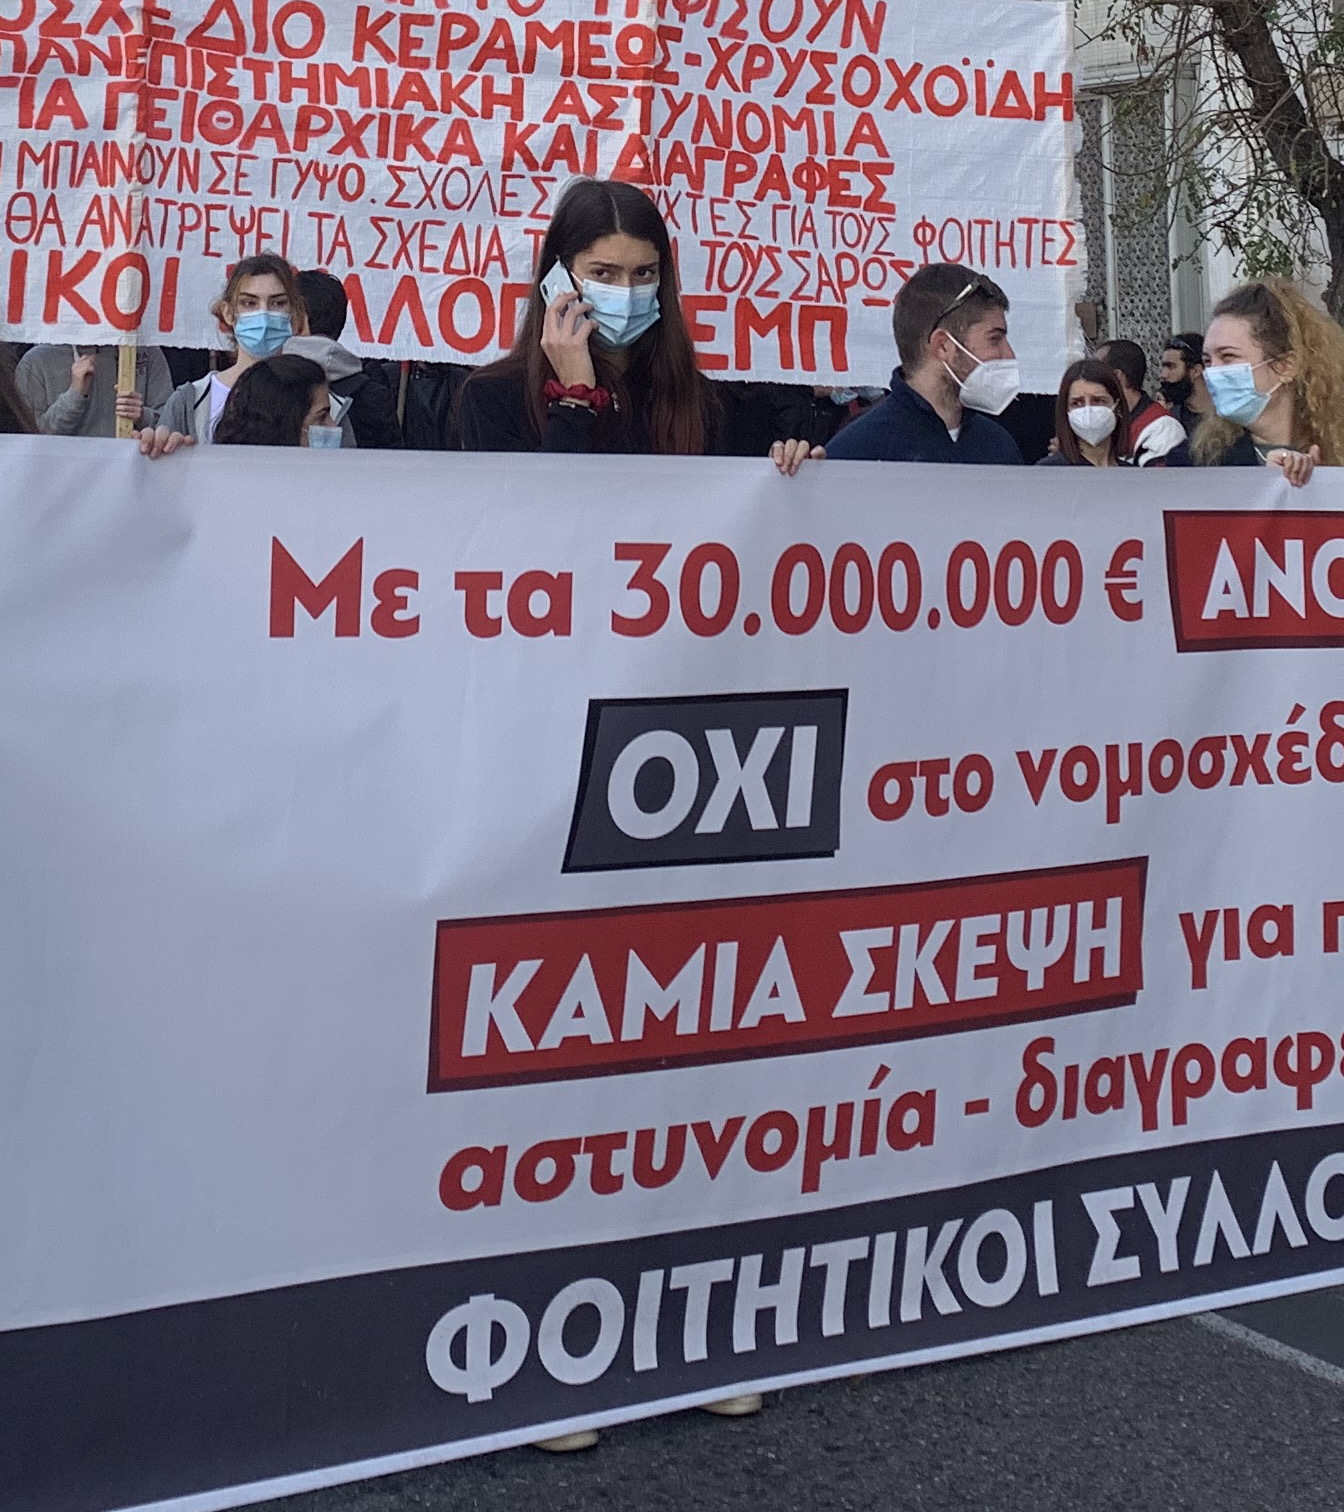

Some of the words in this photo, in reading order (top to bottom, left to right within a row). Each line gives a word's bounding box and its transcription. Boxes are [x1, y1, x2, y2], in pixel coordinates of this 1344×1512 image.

[103, 81, 482, 166] ΠΕΙΘΑΡΧΙΚΑ
[501, 121, 598, 174] ΚΑΙ
[610, 133, 896, 215] ΔΙΑΓΡΑΦΕΣ
[543, 80, 889, 157] ΑΣΤΥΝΟΜΙΑ
[5, 191, 66, 247] ΘΑ
[76, 194, 289, 259] ΑΝΑΤΡΕΨΕΙ
[308, 212, 354, 268] ΤΑ
[364, 217, 509, 278] ΣΧΕΔΙΑ
[701, 240, 783, 299] ΤΟΥΣ
[17, 140, 201, 194] ΜΠΑΙΝΟΥΝ
[208, 151, 259, 196] ΣΕ
[385, 164, 557, 219] ΣΧΟΛΕΣ
[772, 204, 817, 249] ΓΙΑ
[825, 210, 895, 257] ΤΟΥΣ
[913, 215, 1078, 268] ΦΟΙΤΗΤΕΣ
[681, 295, 849, 372] ΕΜΠ
[269, 536, 420, 638] Με
[456, 568, 574, 638] τα
[611, 539, 1083, 637] 30.000.000
[1105, 539, 1144, 622] €
[607, 725, 818, 840] ΟΧΙ
[867, 752, 993, 822] στο
[460, 934, 806, 1059] ΚΑΜΙΑ
[831, 896, 1124, 1019] ΣΚΕΨΗ
[1179, 903, 1294, 990] για
[438, 1065, 936, 1212] αστυνομία
[425, 1199, 1059, 1404] ΦΟΙΤΗΤΙΚΟΙ
